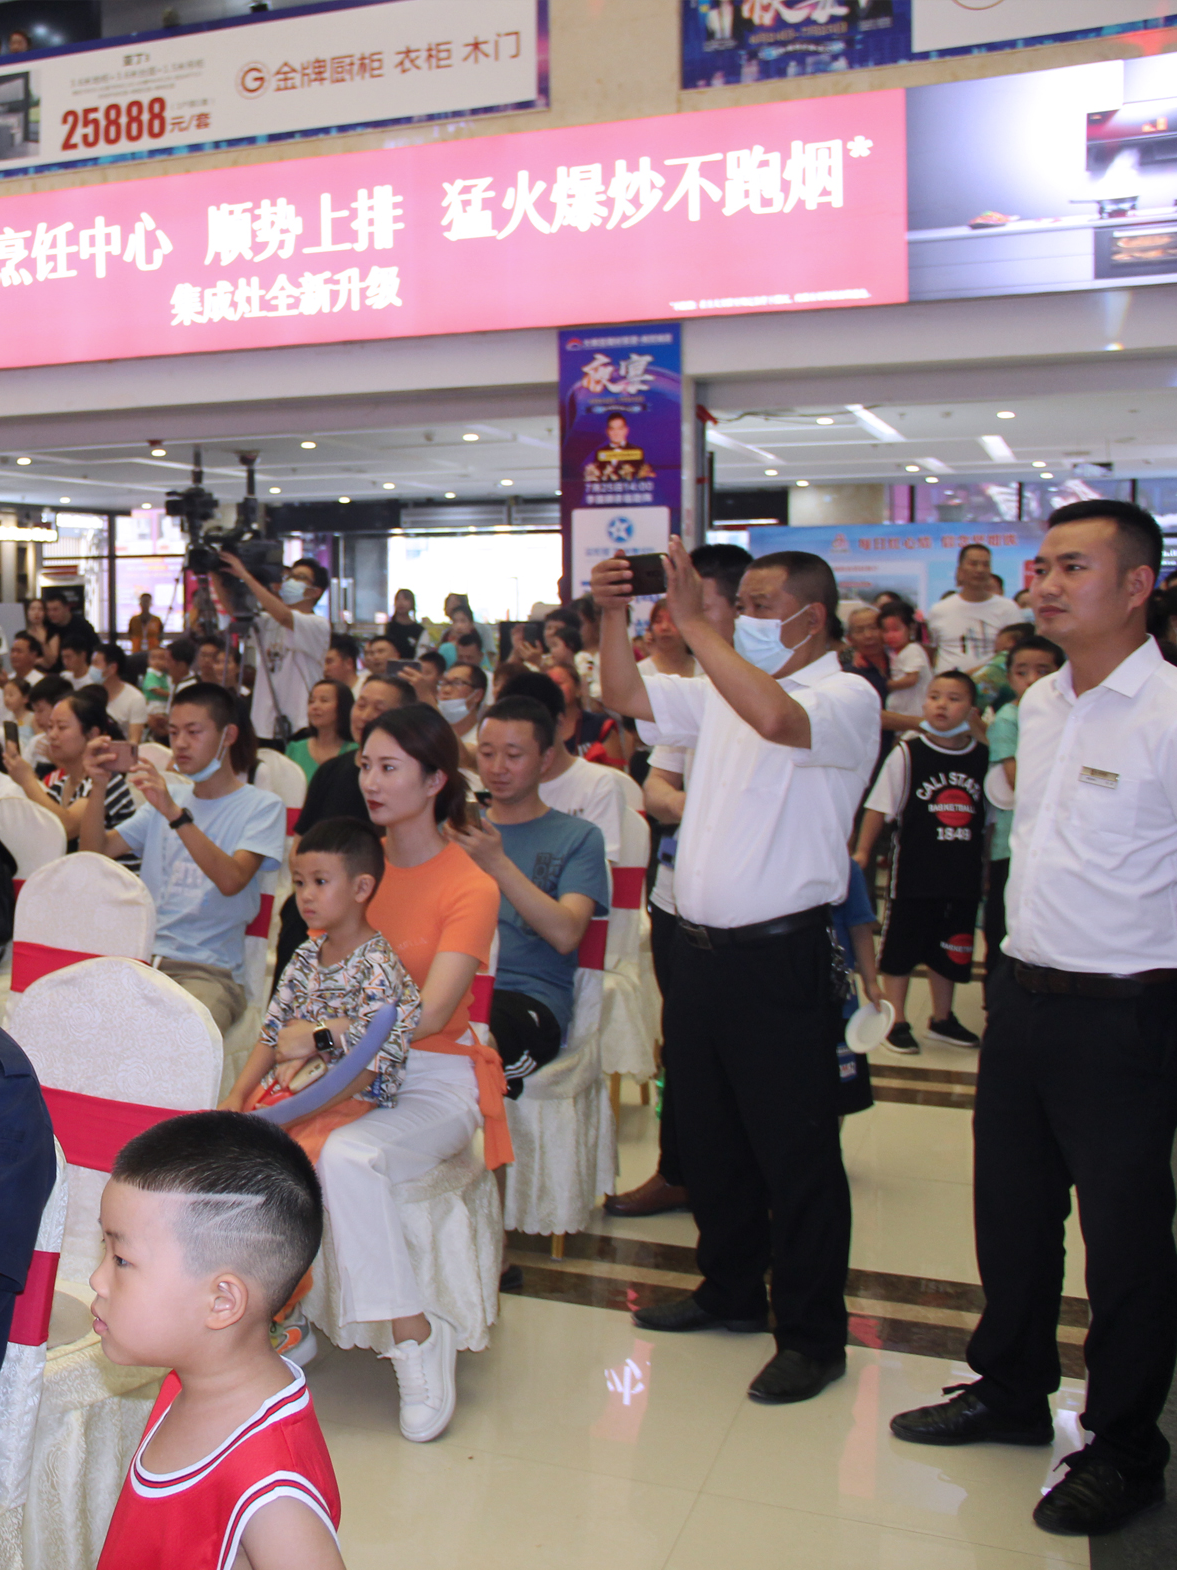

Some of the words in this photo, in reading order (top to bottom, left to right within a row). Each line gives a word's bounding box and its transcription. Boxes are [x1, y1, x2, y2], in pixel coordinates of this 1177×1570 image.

[273, 52, 385, 92] 金牌厨柜
[394, 41, 452, 74] 衣柜
[462, 31, 521, 64] 木门
[61, 97, 166, 151] 25888
[169, 112, 211, 133] 元/套
[204, 184, 405, 266] 顺势上排
[170, 266, 403, 326] 集成灶全新升级
[581, 353, 655, 395] 夜宴
[915, 772, 947, 801] CALI
